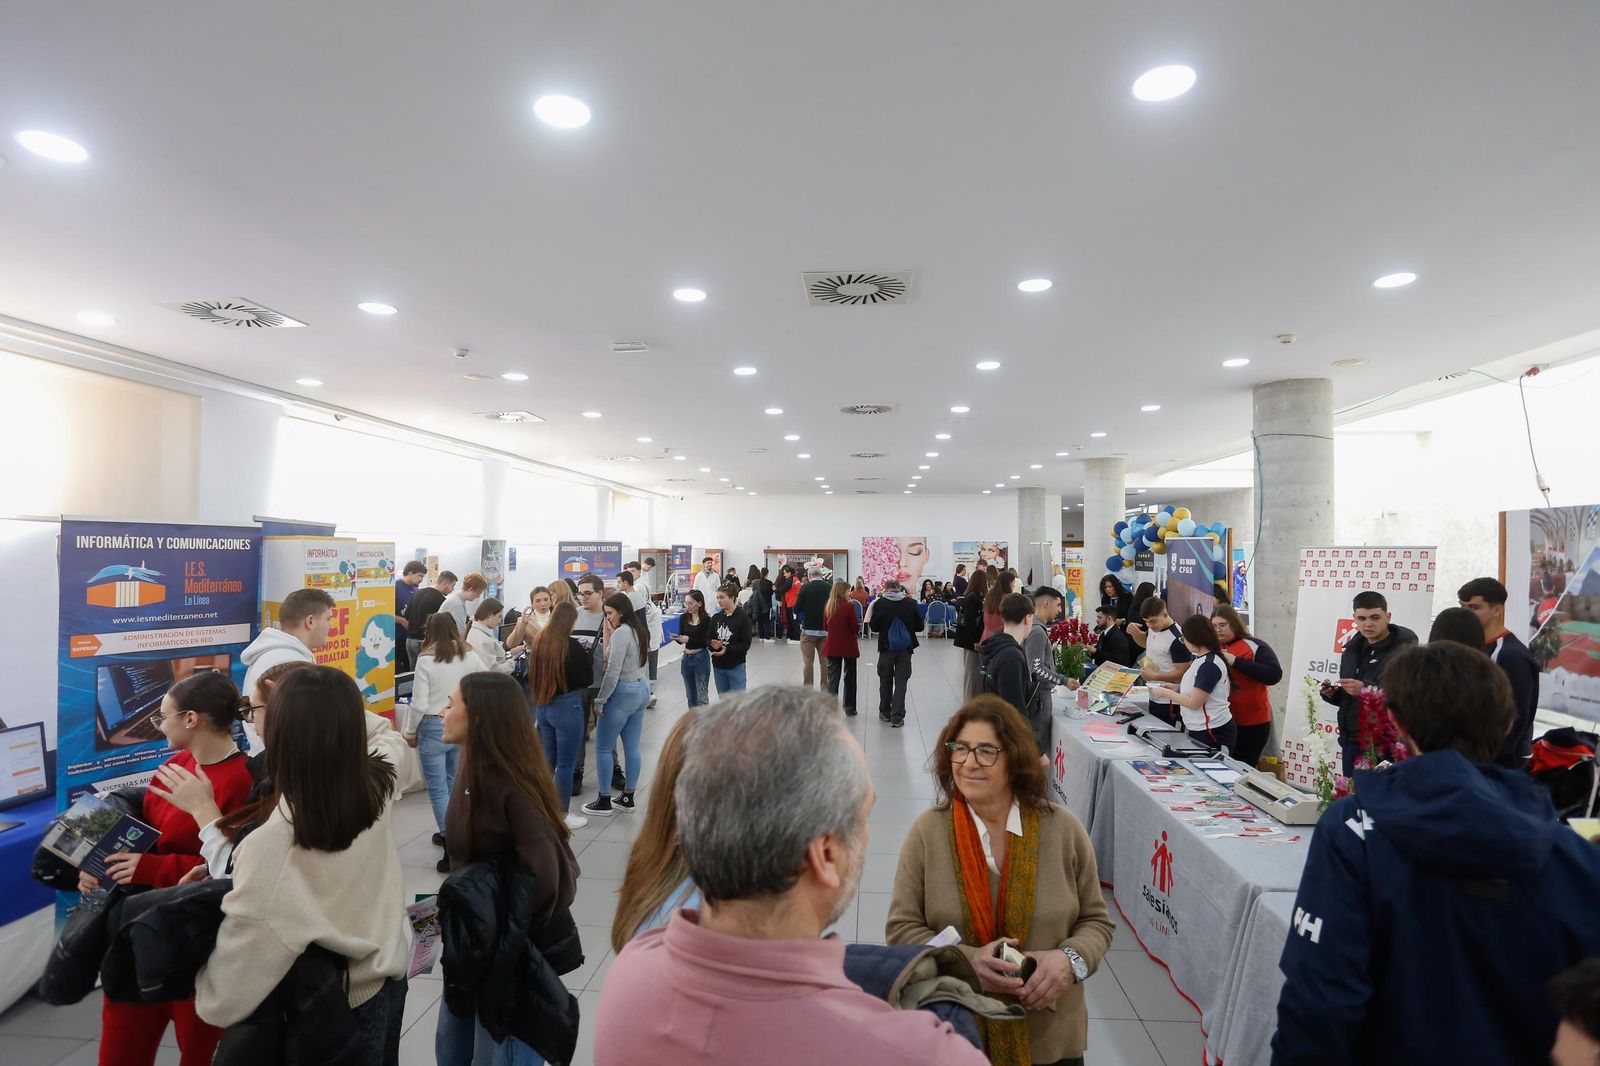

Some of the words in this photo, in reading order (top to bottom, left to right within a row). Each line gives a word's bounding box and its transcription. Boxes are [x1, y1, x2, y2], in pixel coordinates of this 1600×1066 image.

[76, 534, 153, 549] INFORMÁTICA
[157, 537, 164, 549] Y
[166, 537, 251, 551] COMUNICACIONES
[185, 560, 206, 577] I.E.S.
[1068, 569, 1081, 577] FCF
[1179, 566, 1193, 574] CFGS
[184, 579, 242, 594] Mediterráneo
[184, 595, 193, 606] La
[194, 595, 210, 605] Línea
[112, 611, 218, 625] www.iesmediterraneo.net
[122, 631, 184, 641] ADMINISTRACIÓN
[195, 628, 227, 636] SISTEMAS
[137, 638, 190, 649] INFORMÁTICOS
[341, 639, 349, 648] DE
[1308, 659, 1338, 674] sale
